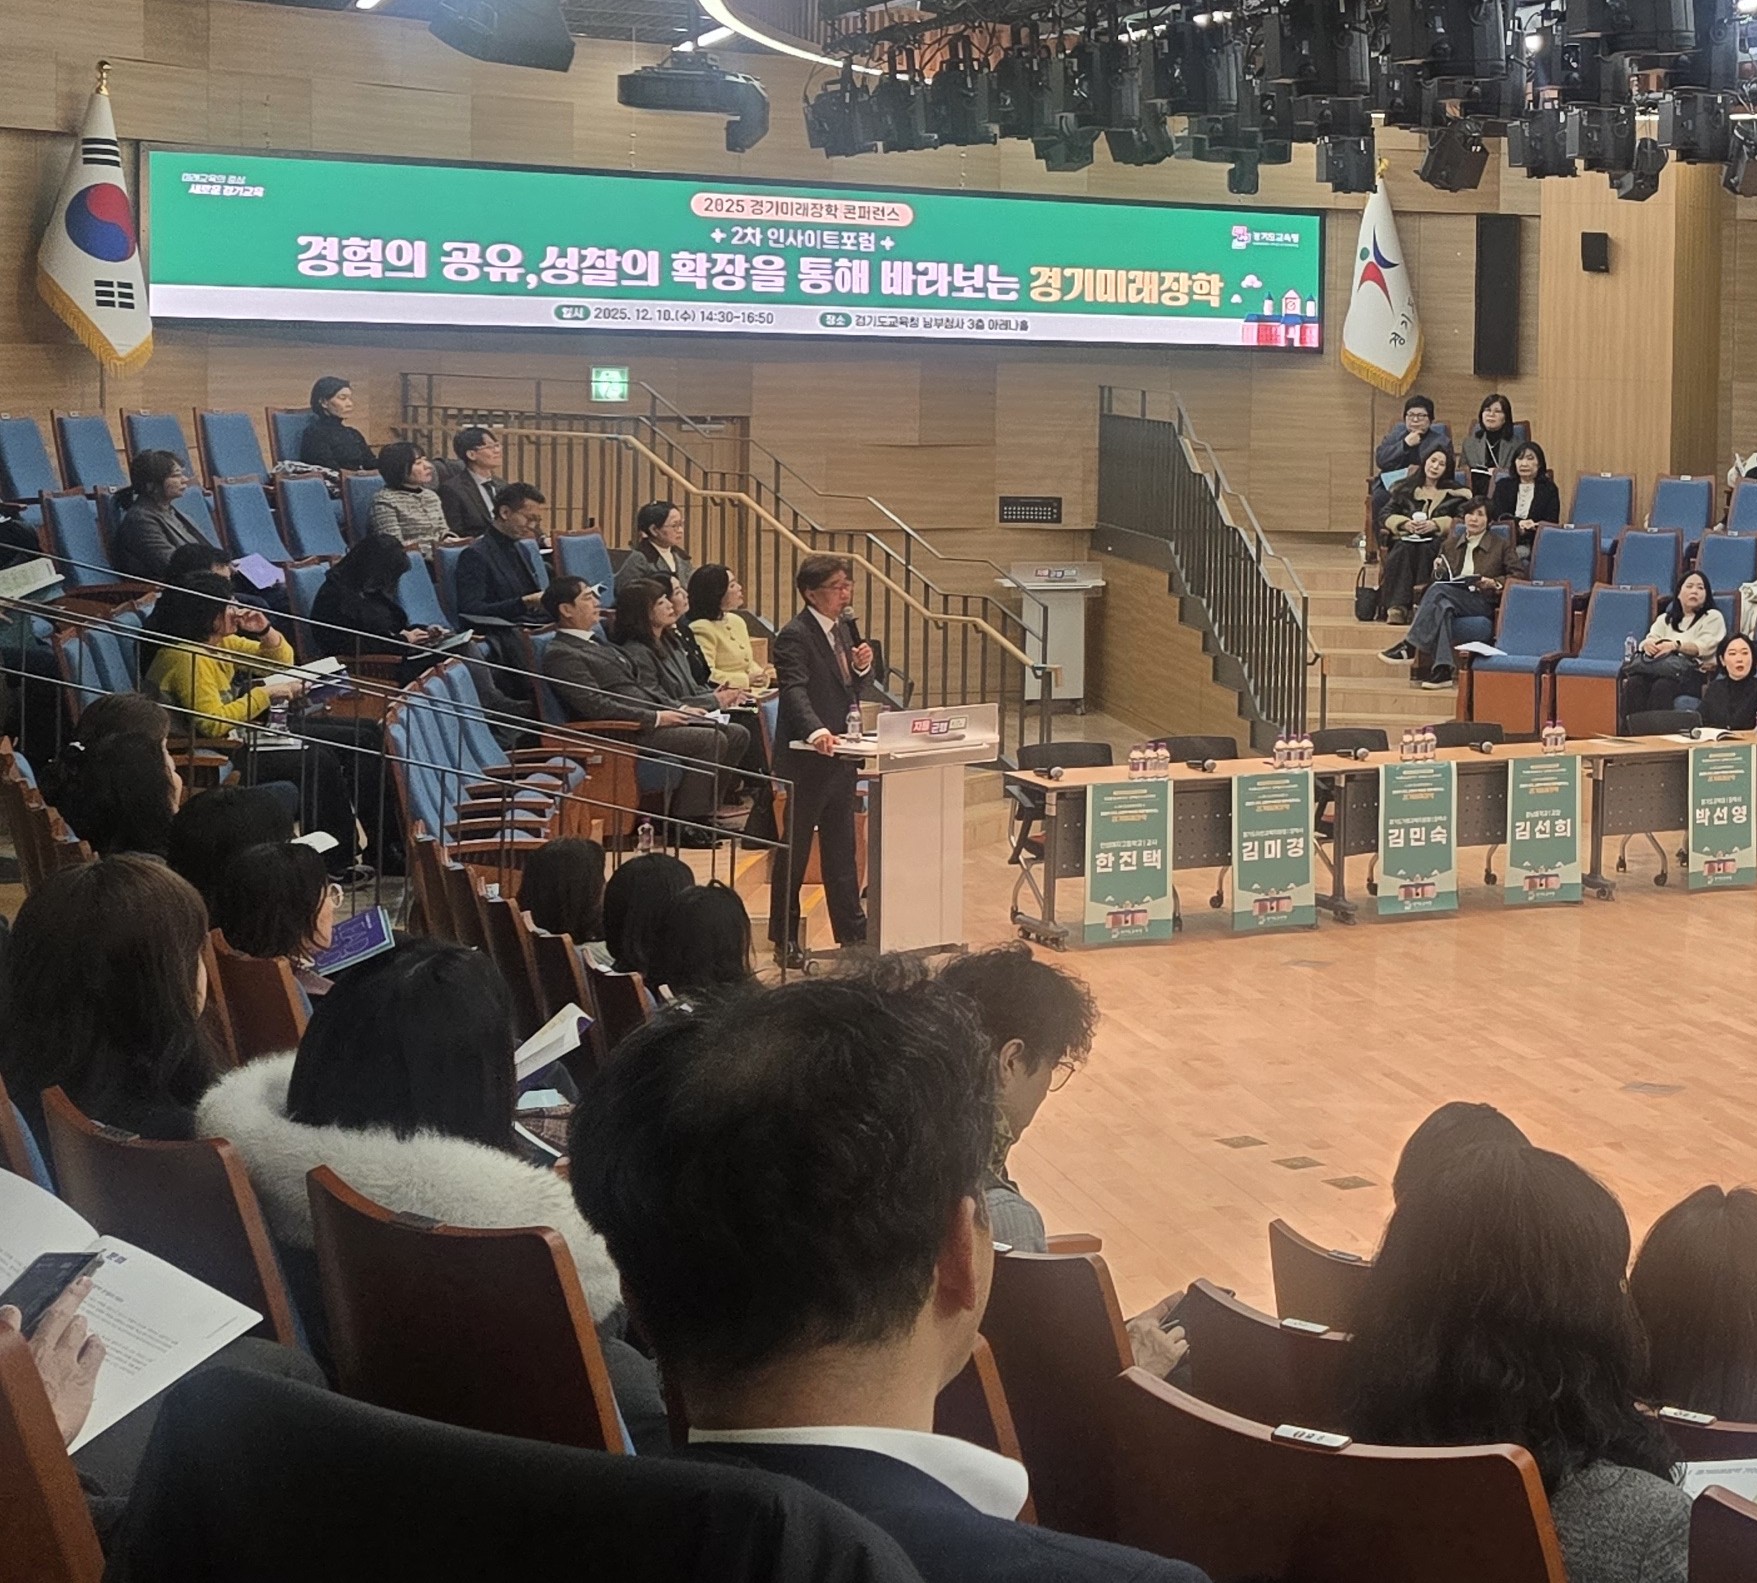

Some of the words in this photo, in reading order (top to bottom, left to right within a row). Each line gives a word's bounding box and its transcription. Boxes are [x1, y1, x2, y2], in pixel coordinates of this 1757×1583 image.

[703, 197, 745, 214] 2025
[750, 200, 839, 219] 경기미래장학
[843, 205, 900, 222] 콘퍼런스
[731, 226, 762, 247] 2차
[767, 227, 876, 252] 인사이트포럼
[297, 235, 427, 278] 경험의
[671, 251, 787, 293] 확장을
[797, 257, 870, 295] 통해
[881, 260, 1020, 301] 바라보는
[1029, 266, 1224, 307] 경기미래장학
[593, 307, 631, 320] 2025.
[635, 309, 652, 320] 12.
[825, 314, 847, 326] 장소
[855, 315, 920, 328] 경기도교육청
[922, 317, 964, 330] 남부청사
[967, 318, 985, 330] 3층
[1695, 805, 1748, 826] 박선영
[1388, 825, 1448, 848] 김민숙
[1515, 818, 1571, 840] 김선희
[1242, 837, 1304, 861] 김미경
[1095, 849, 1162, 873] 한진택
